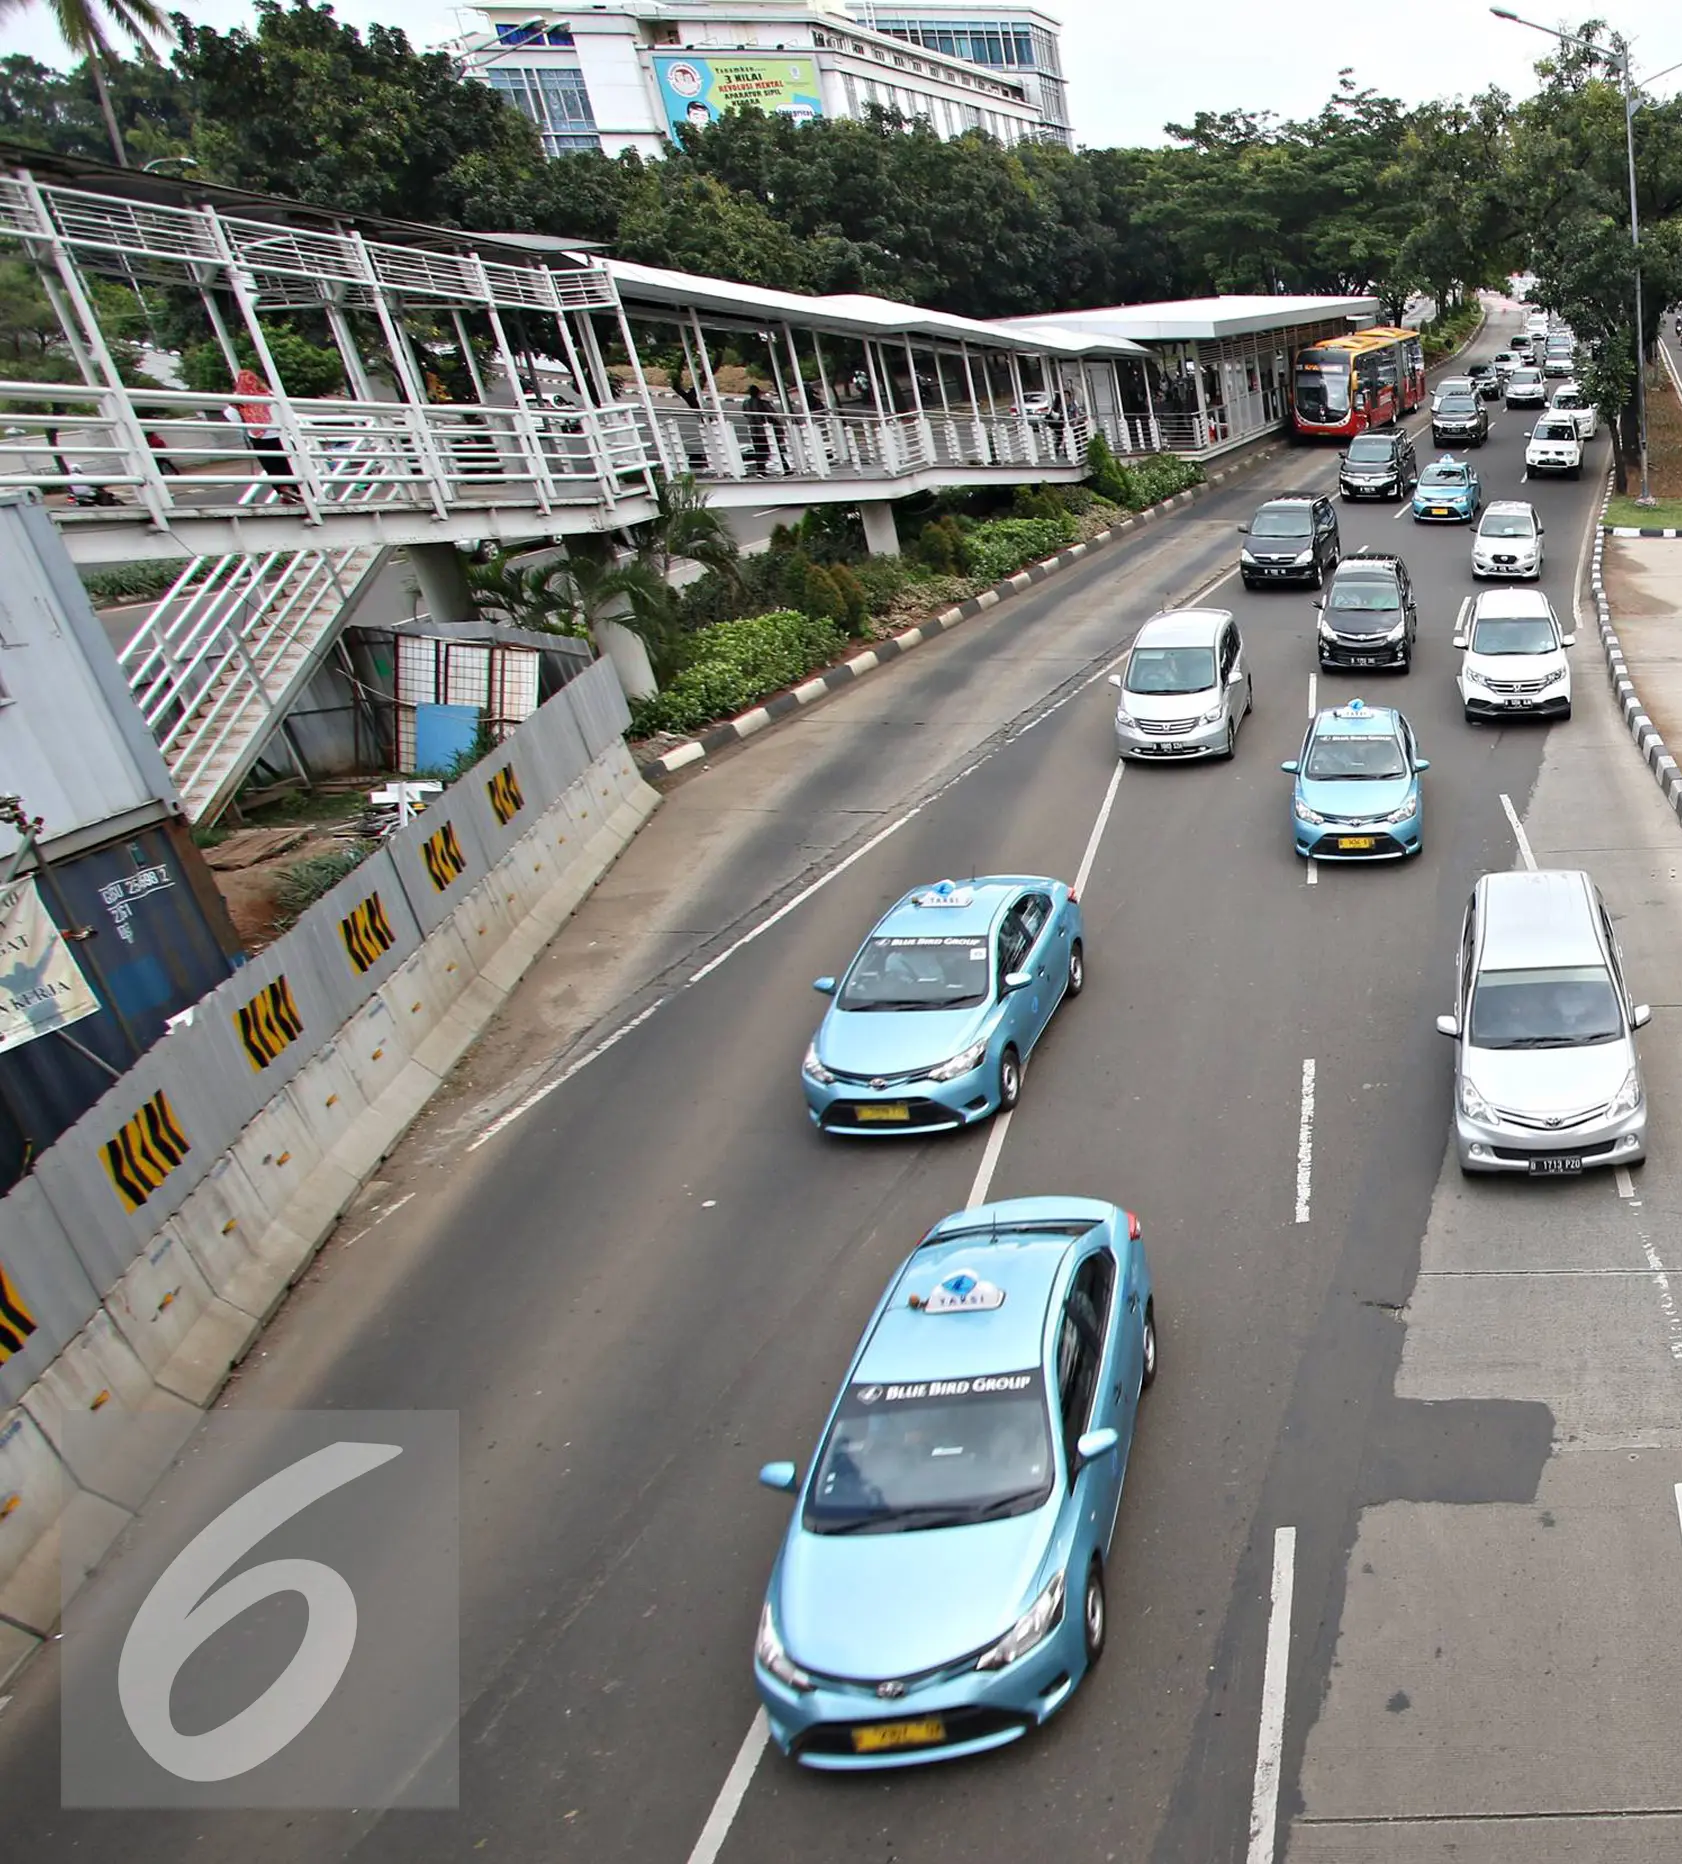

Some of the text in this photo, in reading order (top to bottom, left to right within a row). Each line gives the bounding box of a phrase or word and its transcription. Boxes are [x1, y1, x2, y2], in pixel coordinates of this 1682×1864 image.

[724, 73, 763, 84] 3 NILAI
[718, 83, 753, 92] REVOLUSI
[755, 80, 784, 89] MENTAL
[725, 90, 761, 100] APARATUR
[891, 938, 981, 946] BLUE BIRD GROUP
[939, 1295, 985, 1306] TAKSI
[886, 1375, 1032, 1400] BLUE BIRD GROUP
